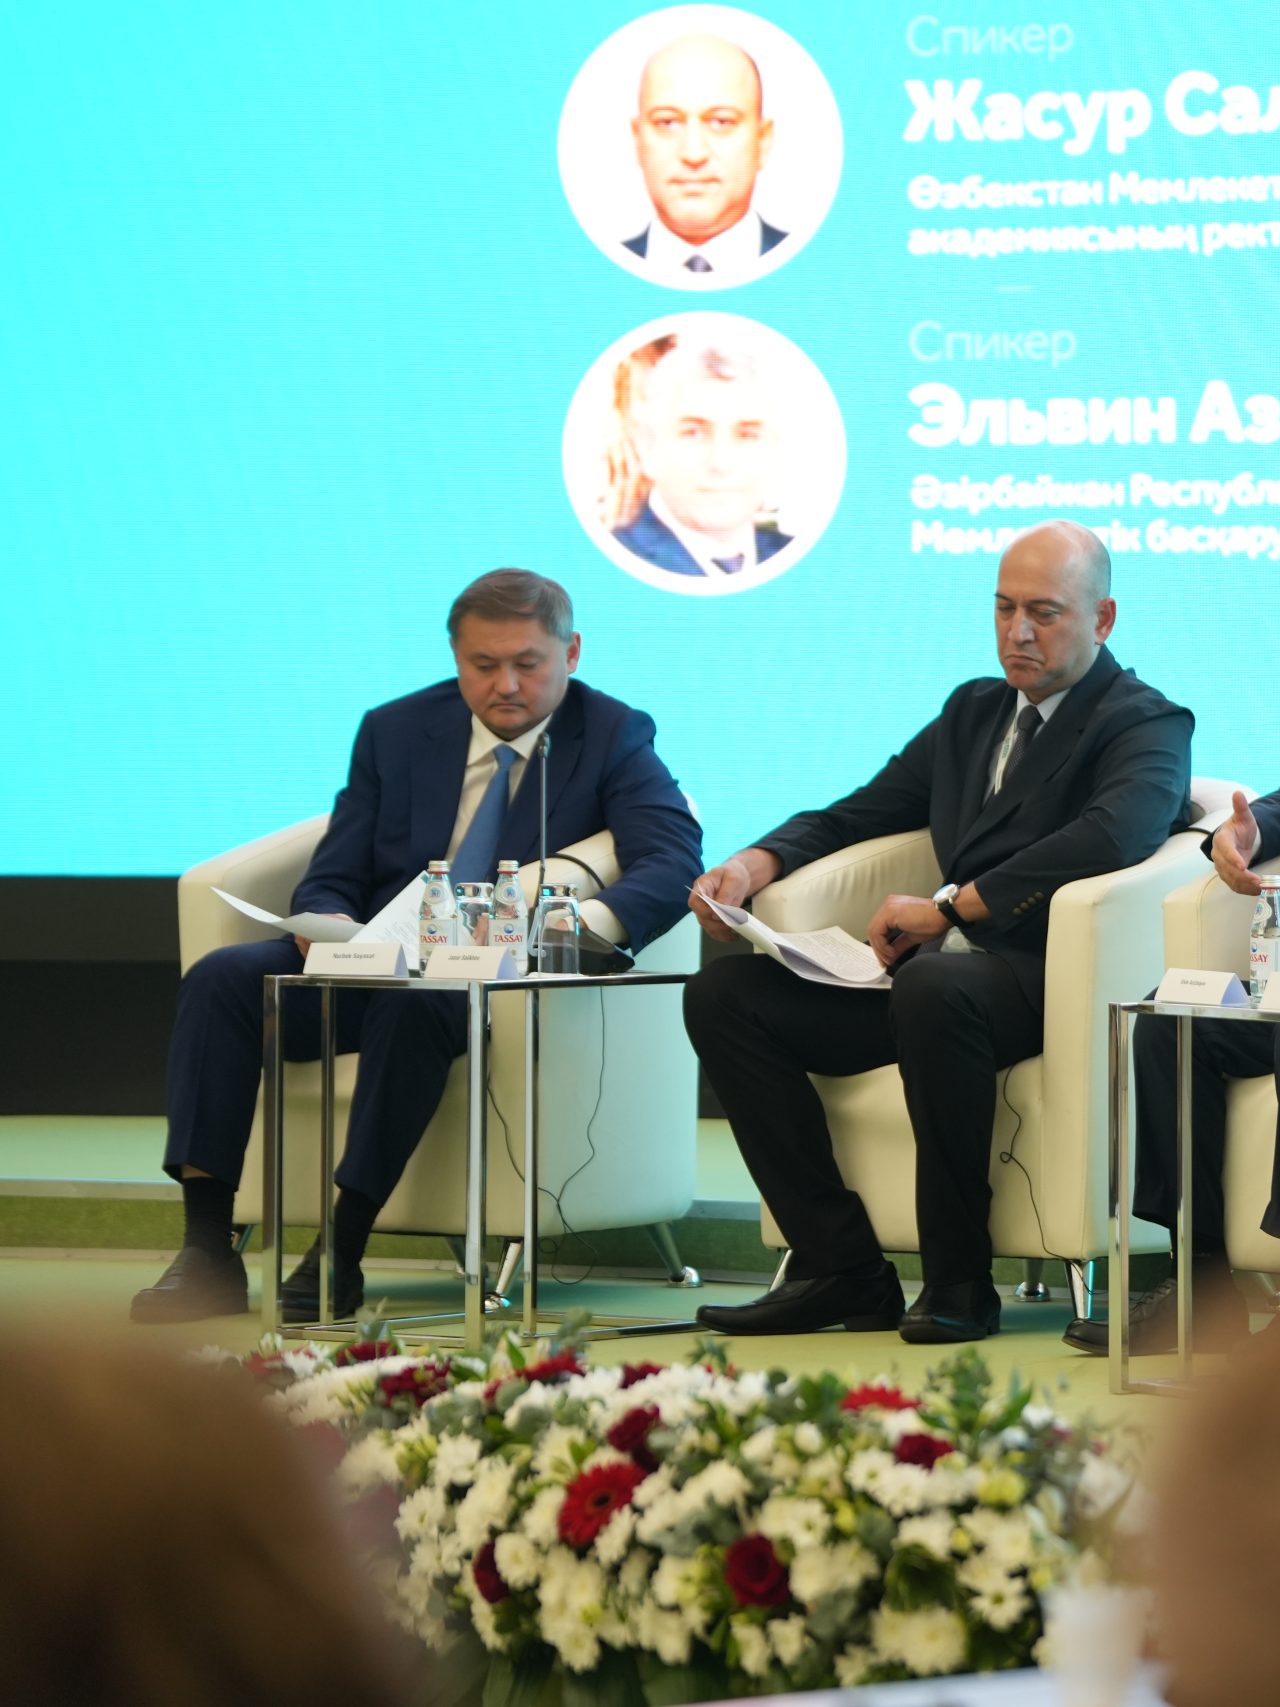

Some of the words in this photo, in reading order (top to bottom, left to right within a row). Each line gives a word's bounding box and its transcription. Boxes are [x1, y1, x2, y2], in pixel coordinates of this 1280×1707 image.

[907, 16, 1072, 60] Спикер
[904, 80, 1150, 154] Жасур
[908, 175, 1103, 209] Өзбекстан
[908, 225, 1198, 257] академиясының
[909, 320, 1076, 367] Спикер
[908, 383, 1176, 447] Эльвин
[911, 474, 1124, 515] Әзірбайжан
[912, 519, 1140, 554] Мемлтік
[420, 935, 448, 943] TASSAY
[494, 934, 523, 942] TASSAY
